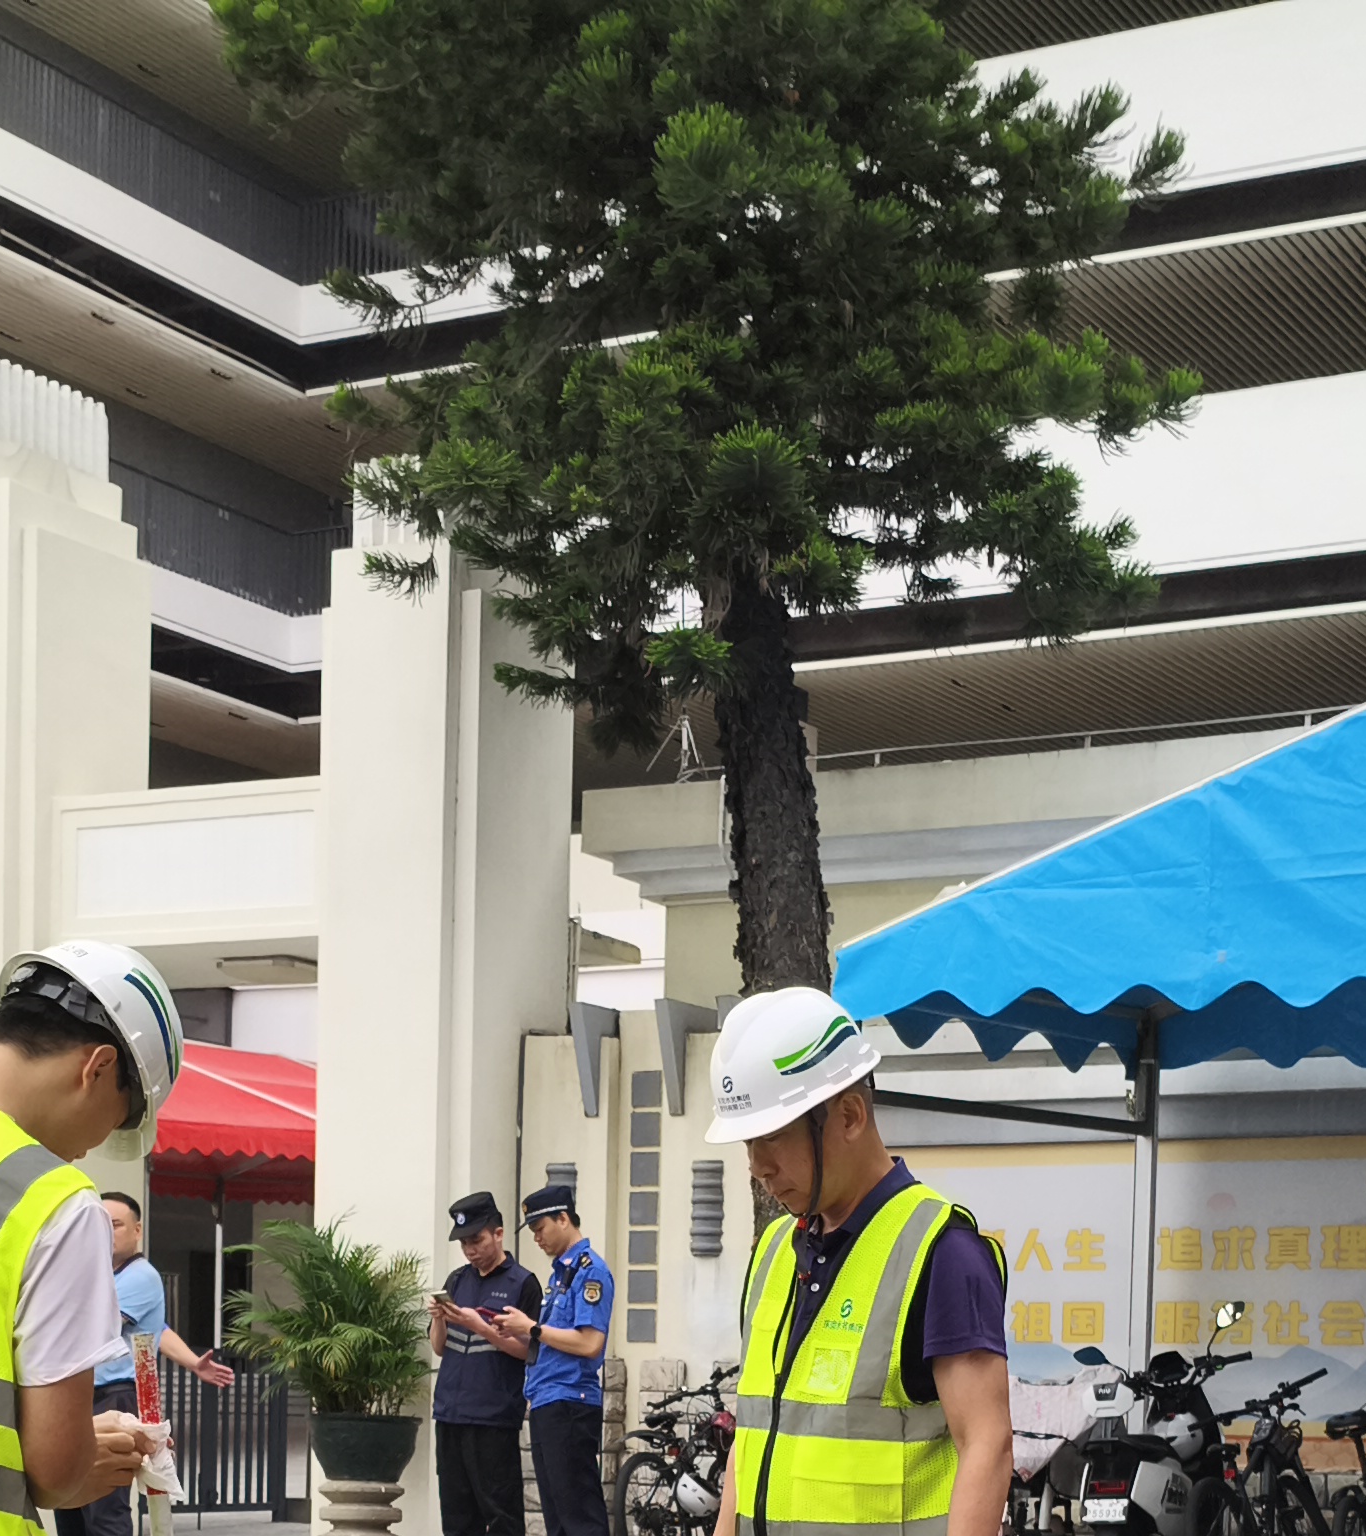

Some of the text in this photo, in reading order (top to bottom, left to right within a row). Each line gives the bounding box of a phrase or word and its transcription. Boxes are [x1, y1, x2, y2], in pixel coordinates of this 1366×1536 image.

[979, 1228, 1107, 1272] 人生
[1009, 1299, 1366, 1346] 祖国 服务社会
